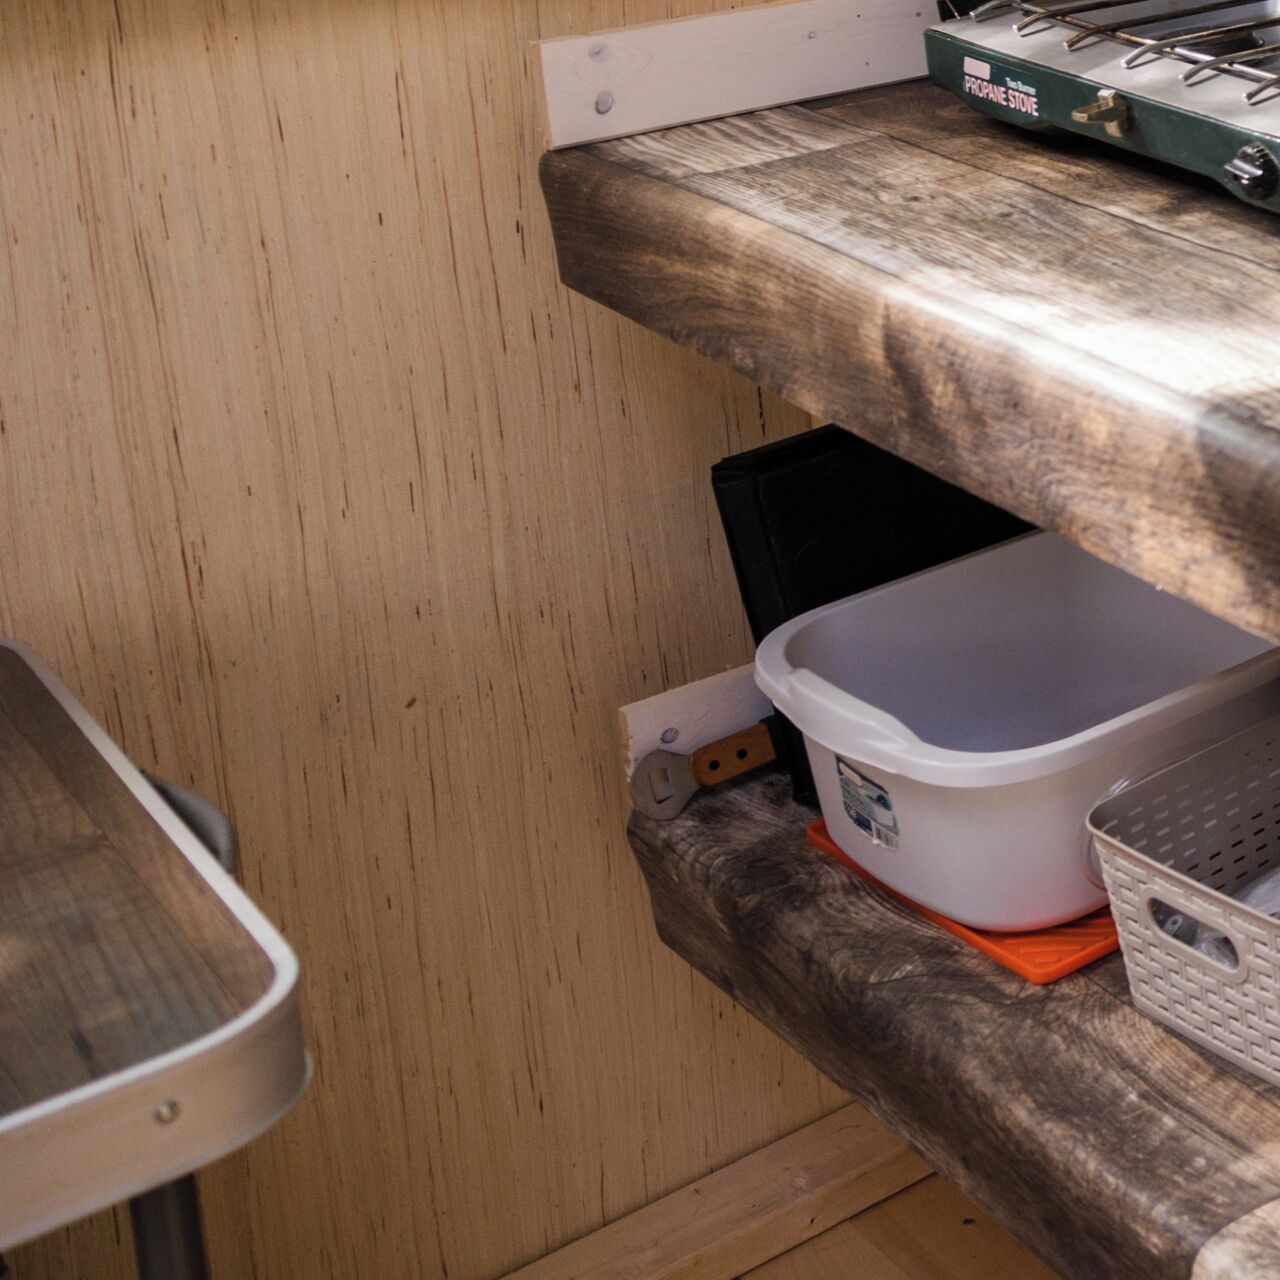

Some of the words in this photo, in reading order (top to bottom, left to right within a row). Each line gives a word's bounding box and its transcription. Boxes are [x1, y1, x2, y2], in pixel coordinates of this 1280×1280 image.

[964, 75, 1008, 106] PROPANE
[1007, 89, 1039, 117] STOVE
[1005, 77, 1018, 90] Two
